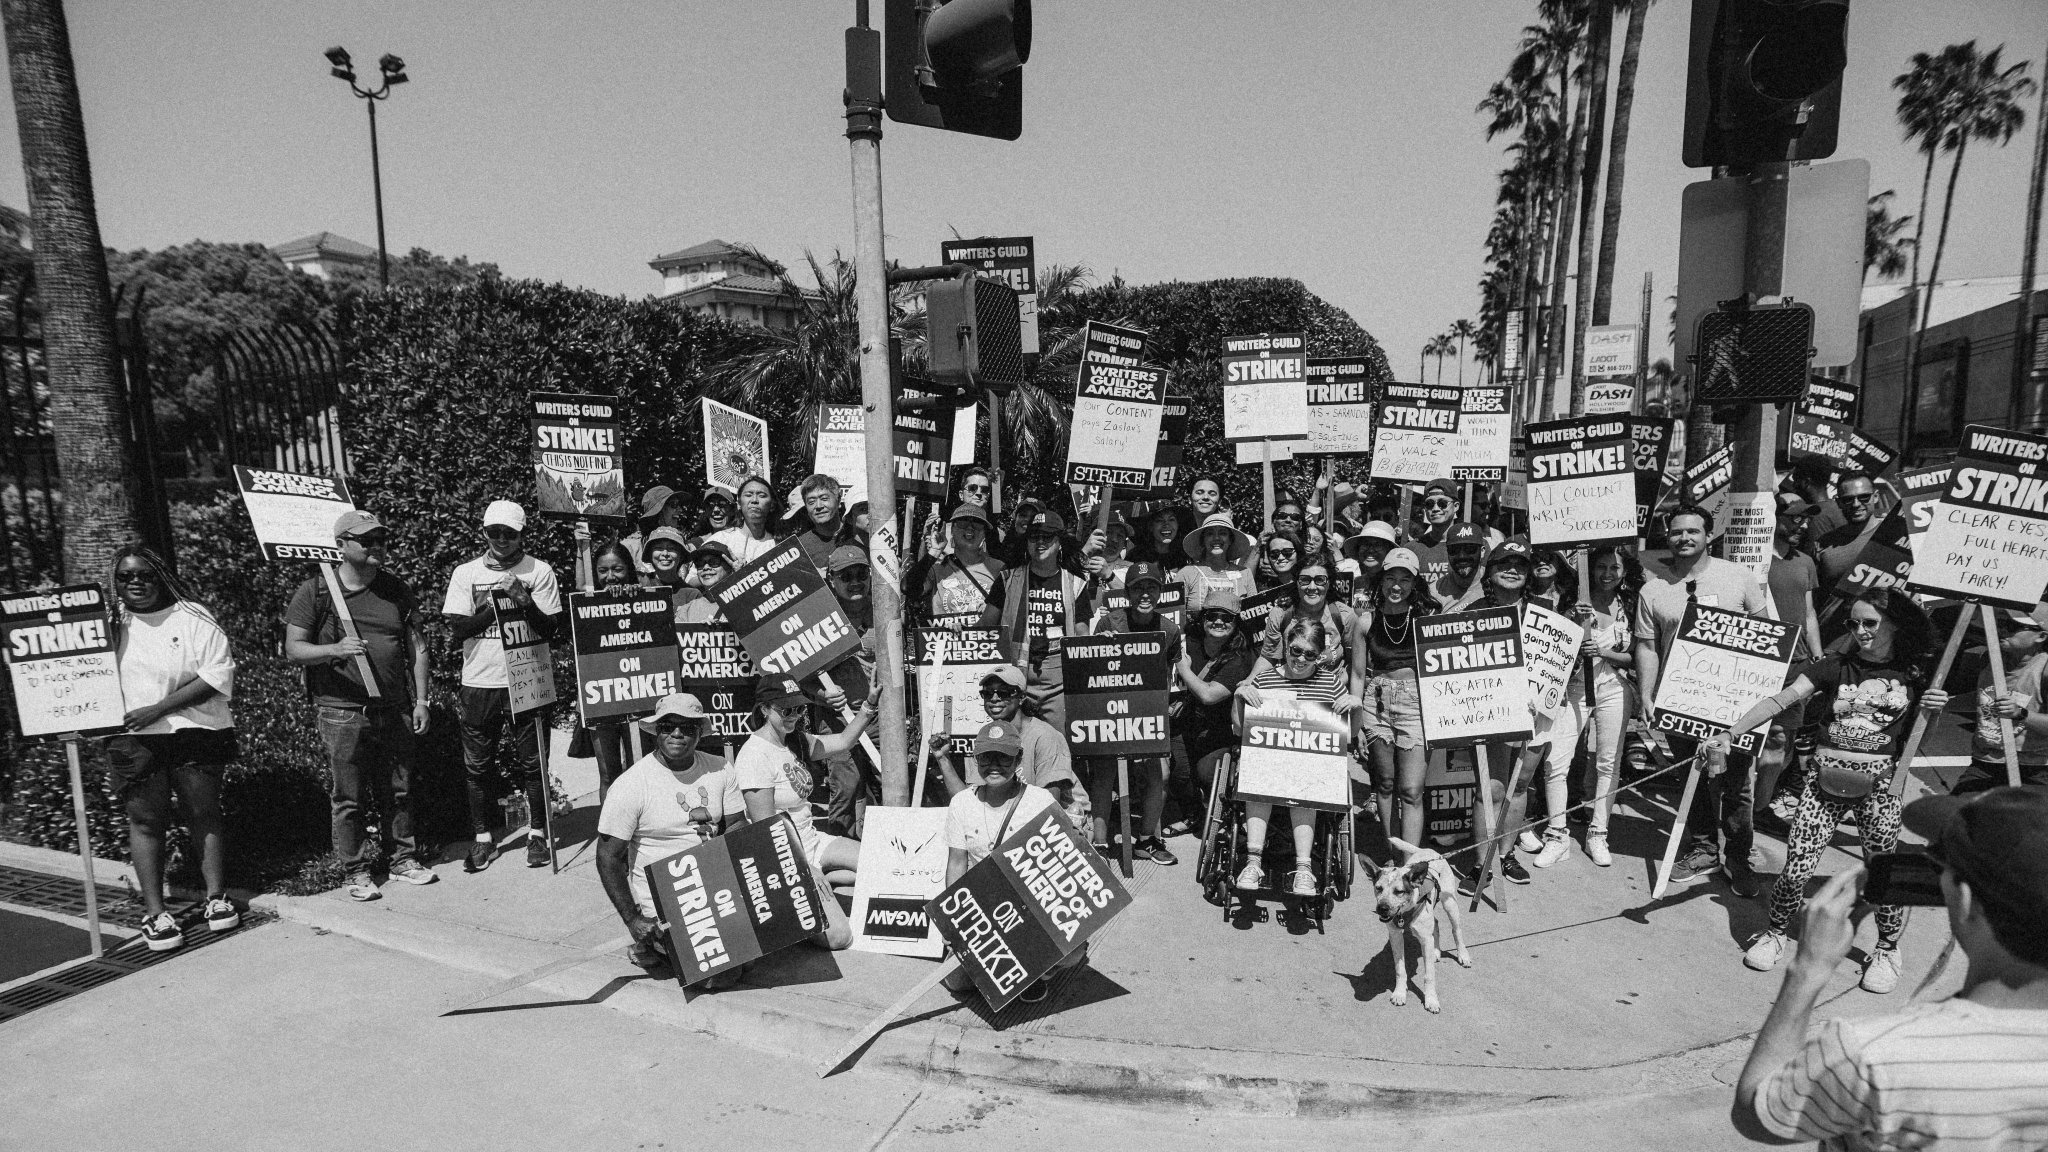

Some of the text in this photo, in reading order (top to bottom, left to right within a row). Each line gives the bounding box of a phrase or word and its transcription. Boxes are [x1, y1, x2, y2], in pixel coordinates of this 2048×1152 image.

[948, 246, 1028, 261] WRITERS GUILD
[984, 260, 994, 268] ON
[1091, 330, 1142, 350] WRITERS GUILD
[1227, 337, 1301, 352] WRITERS GUILD
[1090, 365, 1158, 382] WRITERS
[1228, 358, 1302, 382] STRIKE!
[1338, 364, 1365, 375] GUILD
[1090, 375, 1153, 391] GUILD OF
[1085, 384, 1157, 400] AMERICA
[1307, 382, 1364, 403] TRIKE!
[1388, 386, 1460, 400] WRITERS GUILD
[1590, 388, 1634, 400] DASH
[1834, 389, 1855, 402] GUILD
[535, 402, 613, 418] WRITERS GUILD
[1382, 405, 1456, 430] STRIKE!
[568, 417, 580, 426] ON
[894, 414, 937, 432] AMERICA
[537, 425, 616, 453] STRIKE!
[1379, 432, 1446, 446] OUT FOR
[1531, 427, 1586, 444] WRITERS
[1587, 422, 1625, 437] GUILD
[906, 440, 924, 455] ON
[1401, 446, 1438, 457] WALK
[1571, 441, 1584, 450] ON
[1639, 444, 1658, 455] OF
[1865, 445, 1891, 463] GUILD
[1970, 432, 2048, 461] WRITERS
[1532, 445, 1626, 479] STRIKE!
[1687, 446, 1729, 479] WRITERS
[2018, 463, 2037, 475] ON
[246, 469, 335, 487] WRITERS
[1073, 466, 1146, 486] STRIKE
[251, 483, 343, 501] AMERICA
[1732, 508, 1764, 516] THE MOST
[1948, 509, 2000, 530] CLEAR
[1563, 516, 1636, 533] SUCCESSION
[1730, 517, 1765, 526] IMPORTANT
[1964, 534, 1996, 550] FULL
[1427, 562, 1449, 572] WE
[1739, 555, 1763, 563] WORLD
[1946, 552, 1999, 570] PAY US
[718, 547, 801, 605] WRITERS GUILD
[1959, 571, 2009, 589] FAIRLY!
[761, 581, 774, 595] OF
[1, 589, 100, 614] WRITERS GUILD
[578, 600, 667, 619] WRITERS GUILD
[752, 583, 803, 622] AMERICA
[47, 612, 62, 622] ON
[618, 618, 631, 629] OF
[780, 613, 804, 635] ON
[1045, 614, 1055, 625] &
[1696, 608, 1786, 637] WRITERS
[1422, 616, 1513, 637] WRITERS GUILD
[1526, 610, 1573, 645] Imagine
[1694, 619, 1779, 645] GUILD OF
[9, 619, 108, 657] STRIKE!
[600, 630, 653, 648] AMERICA
[760, 611, 850, 674] STRIKE!
[979, 642, 997, 650] OF
[1461, 634, 1474, 643] ON
[1686, 628, 1781, 658] AMERICA
[682, 647, 738, 664] GUILD
[1066, 642, 1161, 659] WRITERS GUILD
[1424, 639, 1517, 673] STRIKE!
[1523, 632, 1575, 666] going through
[619, 656, 641, 673] ON
[1107, 660, 1121, 671] OF
[1681, 645, 1721, 678] YOU
[44, 673, 69, 682] FUCK
[681, 663, 761, 678] AMERICA
[512, 679, 534, 692] TEXT
[584, 671, 677, 705] STRIKE!
[1087, 673, 1144, 689] AMERICA
[531, 690, 550, 700] NIGHT
[711, 693, 733, 710] ON
[1452, 694, 1493, 710] supports
[1717, 694, 1740, 706] THE
[1106, 699, 1129, 714] ON
[1070, 715, 1166, 743] STRIKE!
[1289, 720, 1302, 728] ON
[1438, 715, 1457, 728] the
[1249, 725, 1340, 753] STRIKE!
[1430, 819, 1462, 831] GUILD
[1039, 815, 1115, 909] WRITERS
[766, 873, 782, 890] OF
[769, 819, 816, 931] WRITERS GUILD
[1026, 835, 1093, 920] GUILD OF
[739, 857, 773, 925] AMERICA
[1003, 847, 1081, 942] AMERICA
[714, 888, 737, 918] ON
[667, 854, 731, 973] STRIKE!
[867, 909, 928, 927] WGAW
[992, 901, 1025, 934] ON
[939, 887, 1029, 996] STRIKE
